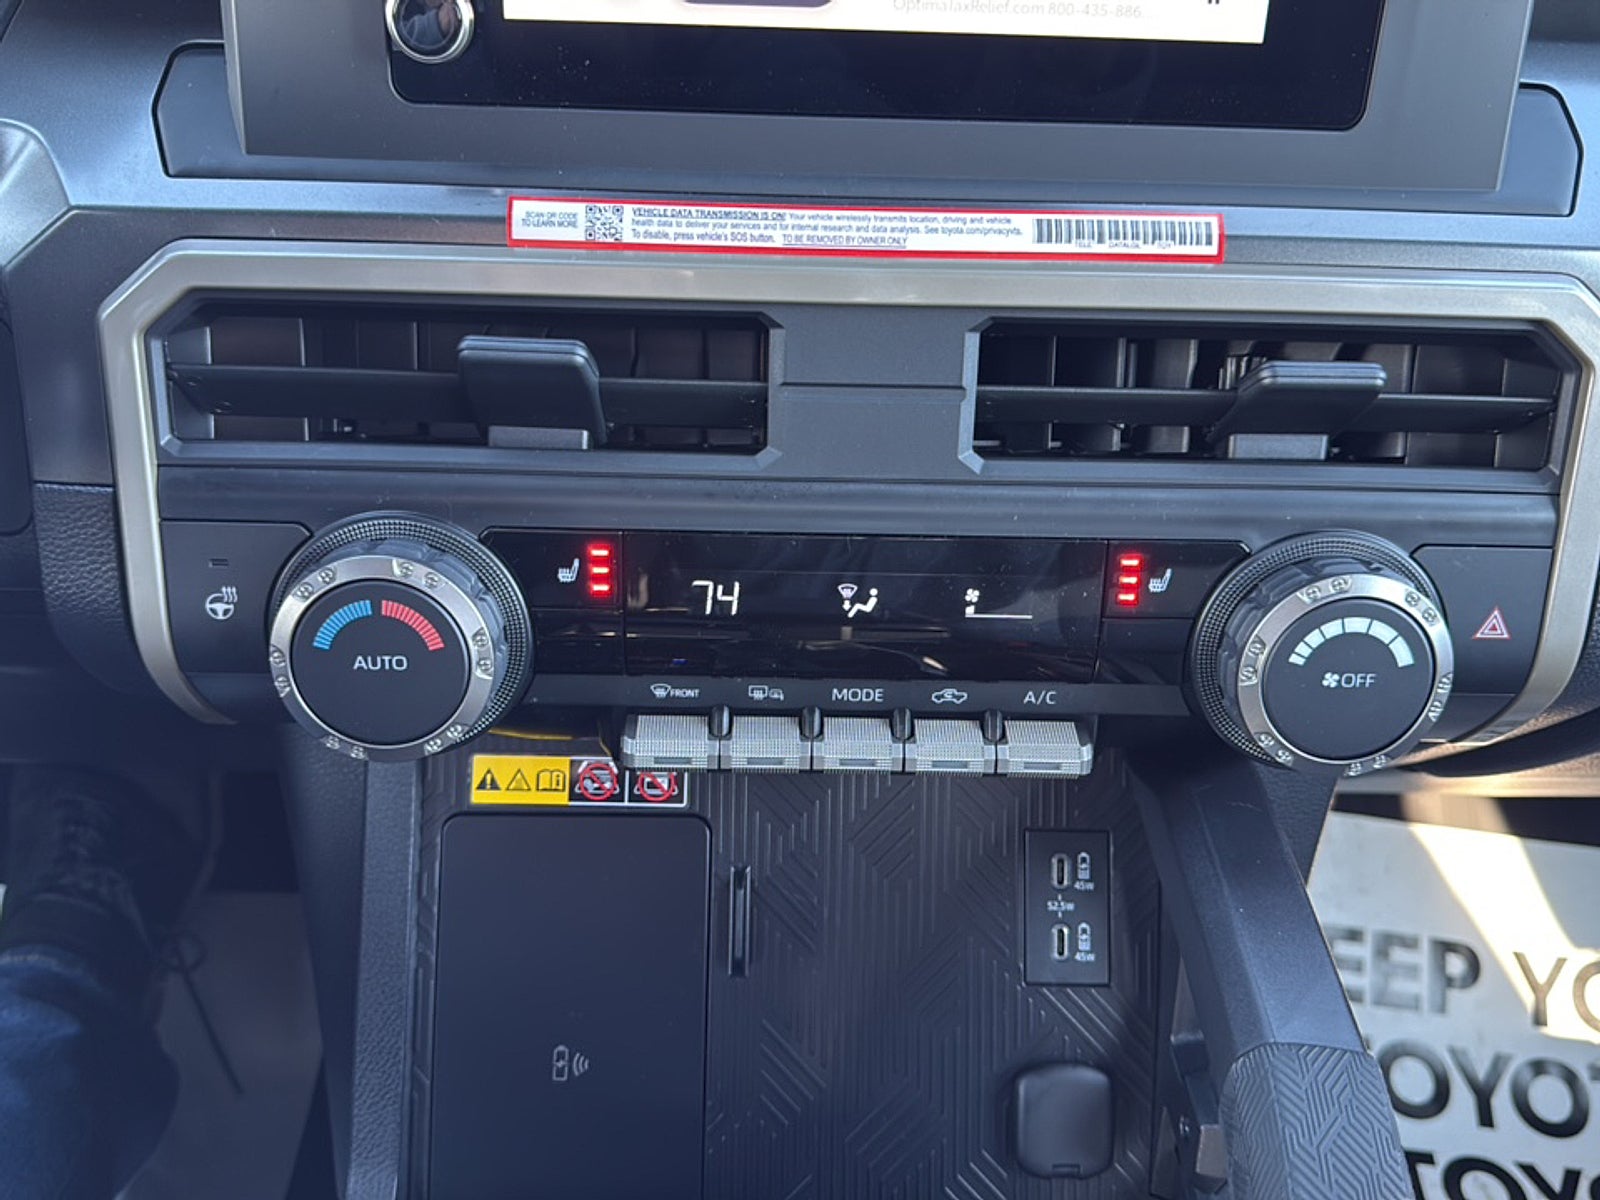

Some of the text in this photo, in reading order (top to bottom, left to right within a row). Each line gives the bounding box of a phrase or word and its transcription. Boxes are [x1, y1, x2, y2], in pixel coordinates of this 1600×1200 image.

[521, 218, 578, 228] TO LEARN MORE
[525, 210, 545, 219] SCAN
[558, 212, 578, 220] CODE
[631, 207, 668, 218] VEHICLE
[670, 208, 693, 219] DATA
[695, 209, 760, 220] TRANSMISSION
[761, 211, 770, 221] IS
[789, 212, 806, 221] Your
[807, 213, 834, 221] vehicle
[835, 213, 871, 223] wirelessly
[873, 215, 907, 223] transmits
[909, 215, 940, 225] location,
[942, 216, 967, 226] driving
[985, 217, 1012, 225] vehicle
[631, 218, 654, 227] health
[657, 218, 673, 228] data
[676, 219, 683, 228] to
[685, 219, 710, 228] deliver
[712, 221, 728, 231] your
[730, 221, 761, 230] services
[763, 222, 778, 231] and
[779, 222, 789, 231] for
[791, 223, 819, 231] internal
[821, 223, 852, 232] research
[855, 224, 870, 233] and
[871, 224, 888, 233] data
[889, 225, 921, 235] analysis.
[924, 225, 939, 234] See
[631, 228, 907, 247] To disable, press vehicle's SOS button. TO BE REMOVED BY OWNER ONLY
[691, 580, 740, 616] 74
[353, 655, 408, 671] AUTO
[1341, 673, 1376, 688] OFF
[670, 687, 699, 699] FRONT
[831, 687, 884, 703] MODE
[1023, 690, 1057, 706] A/C
[1074, 880, 1095, 891] 45W
[1074, 951, 1096, 962] 45W
[1365, 1034, 1600, 1138] OYO
